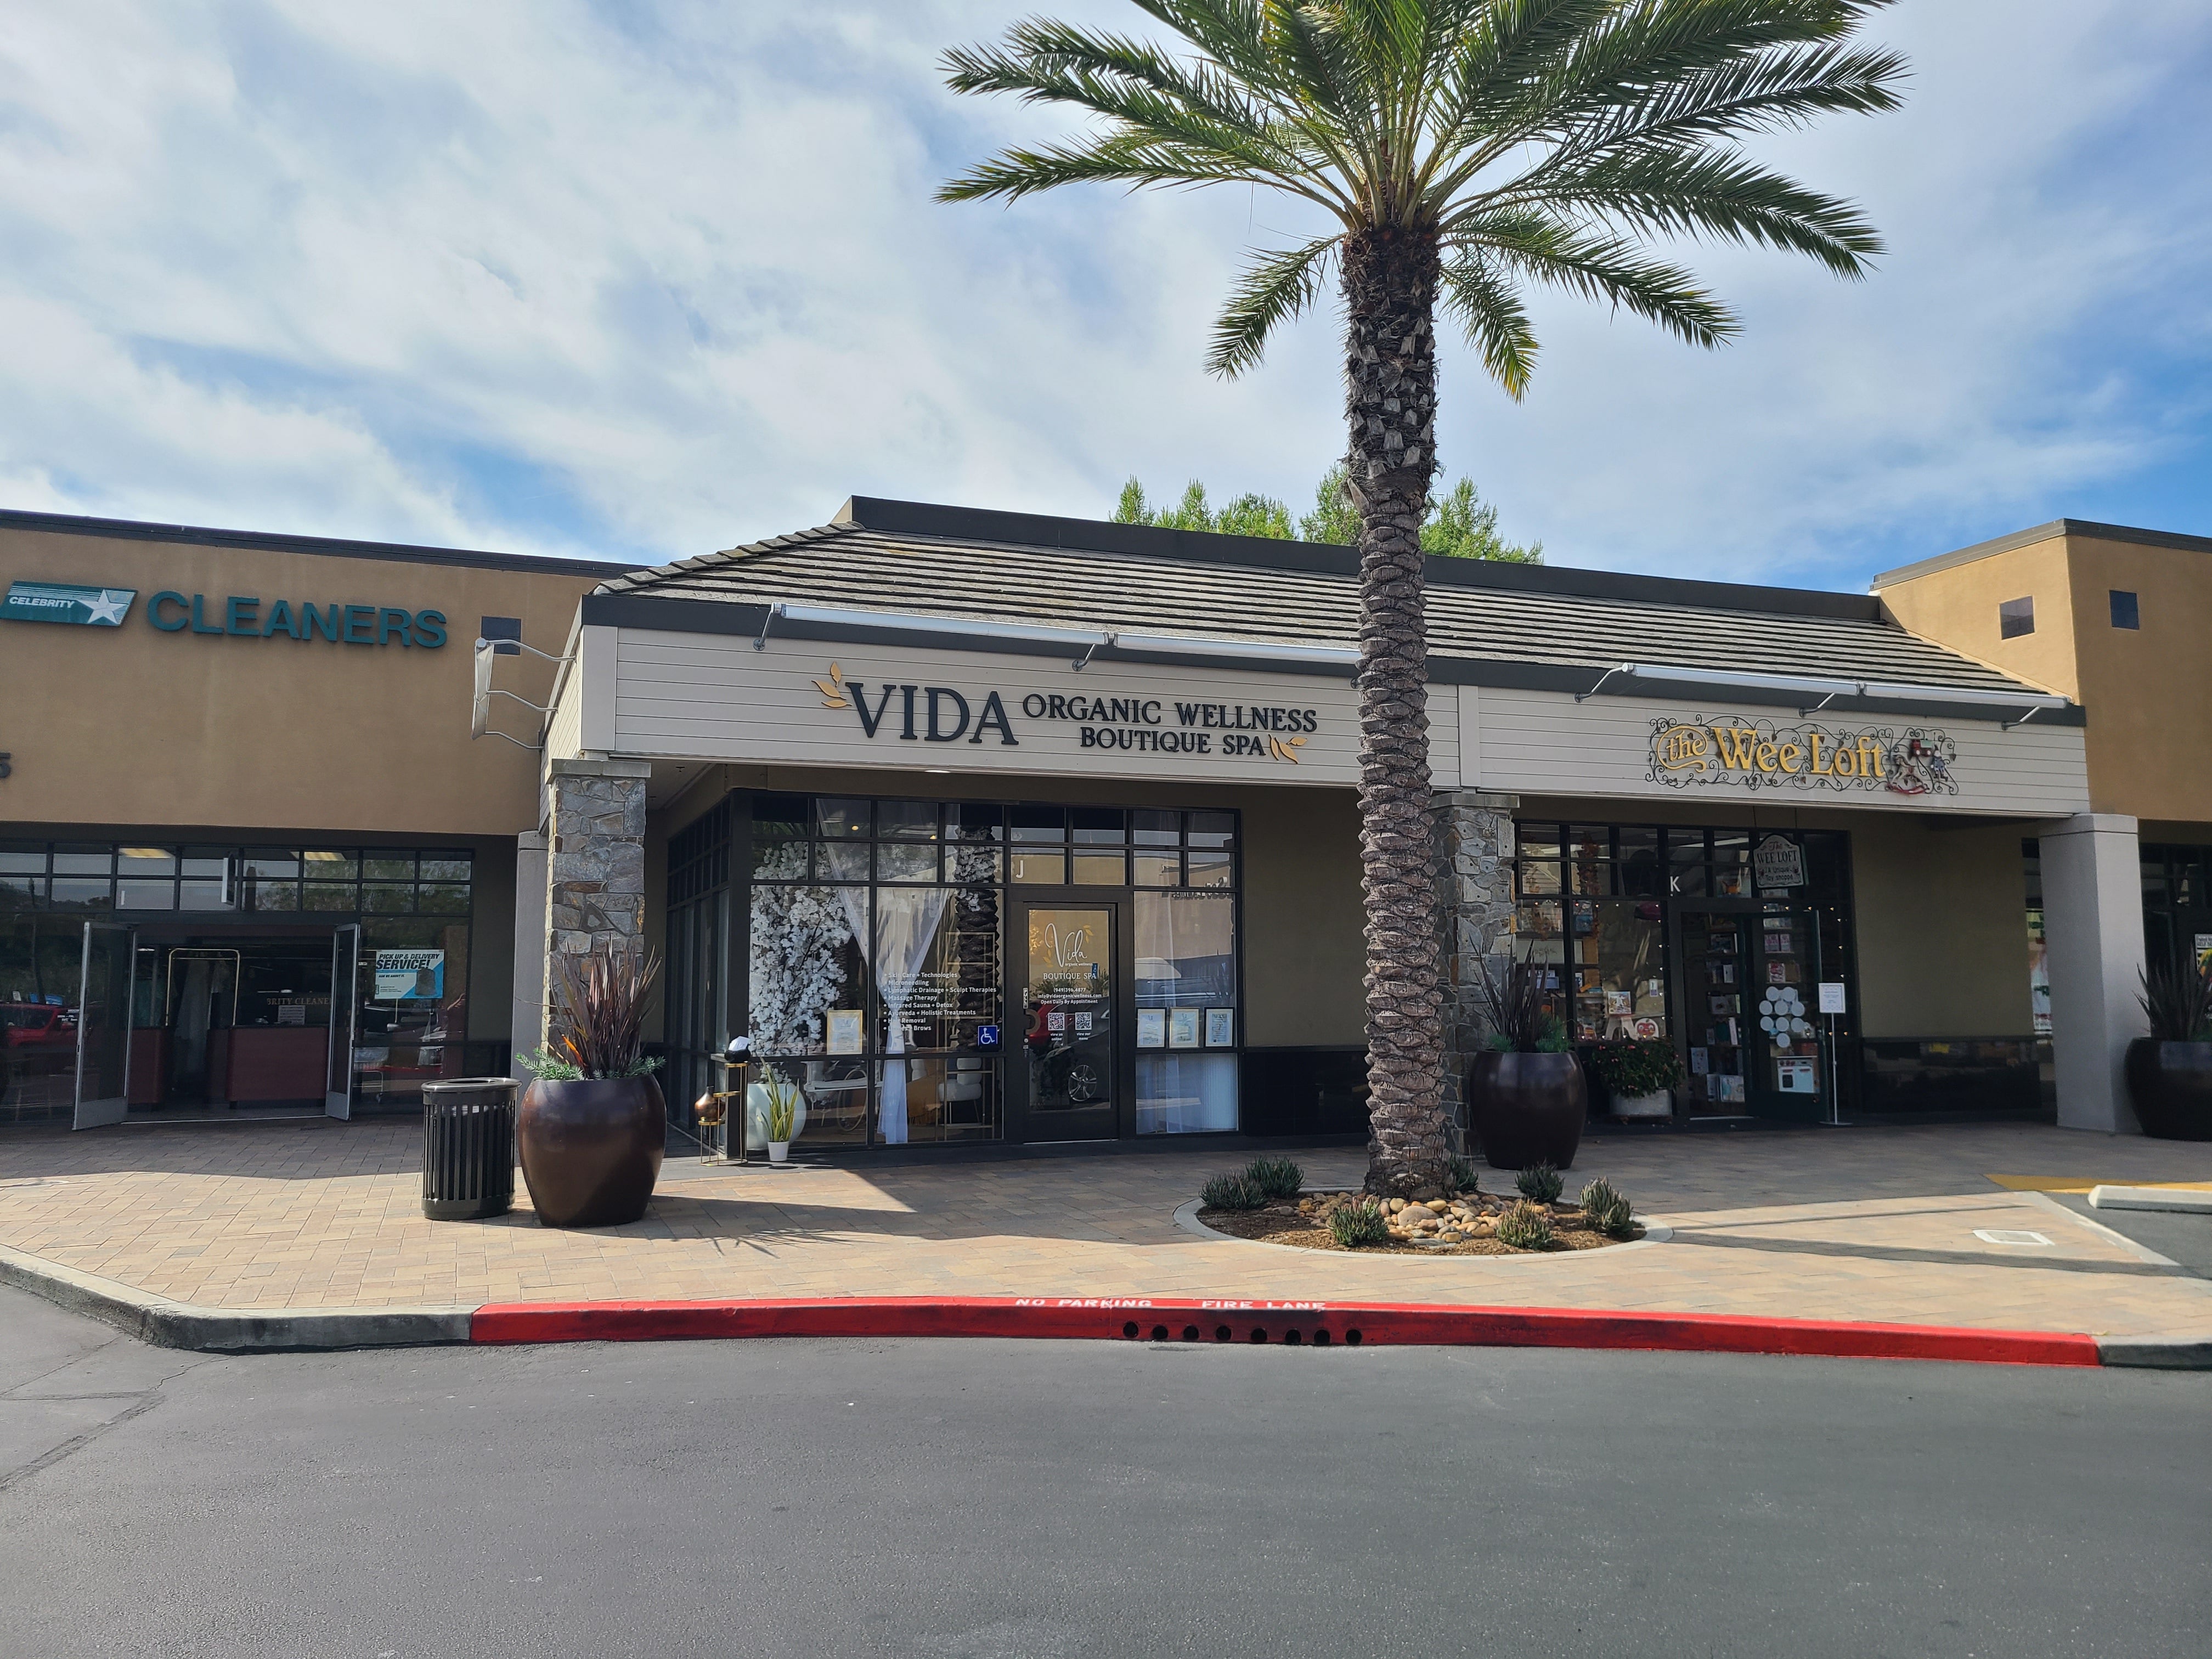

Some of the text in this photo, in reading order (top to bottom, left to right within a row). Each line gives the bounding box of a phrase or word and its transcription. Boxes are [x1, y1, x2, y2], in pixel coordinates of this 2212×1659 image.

[9, 596, 75, 608] CELEBRITY
[148, 591, 447, 648] CLEANERS
[844, 681, 1019, 746] VIDA
[1022, 693, 1318, 733] ORGANIC WELLNESS
[1080, 726, 1266, 756] BOUTIQUE SPA
[1663, 726, 1886, 777] the Wee Loft
[1015, 860, 1024, 878] J
[1757, 850, 1797, 864] WEE LOFT
[1670, 876, 1680, 892] K
[1045, 923, 1087, 967] Vida
[376, 959, 431, 969] SERVICE!
[1058, 1299, 1153, 1308] PARKING
[1201, 1300, 1254, 1308] FIRE
[1267, 1301, 1327, 1310] LANE
